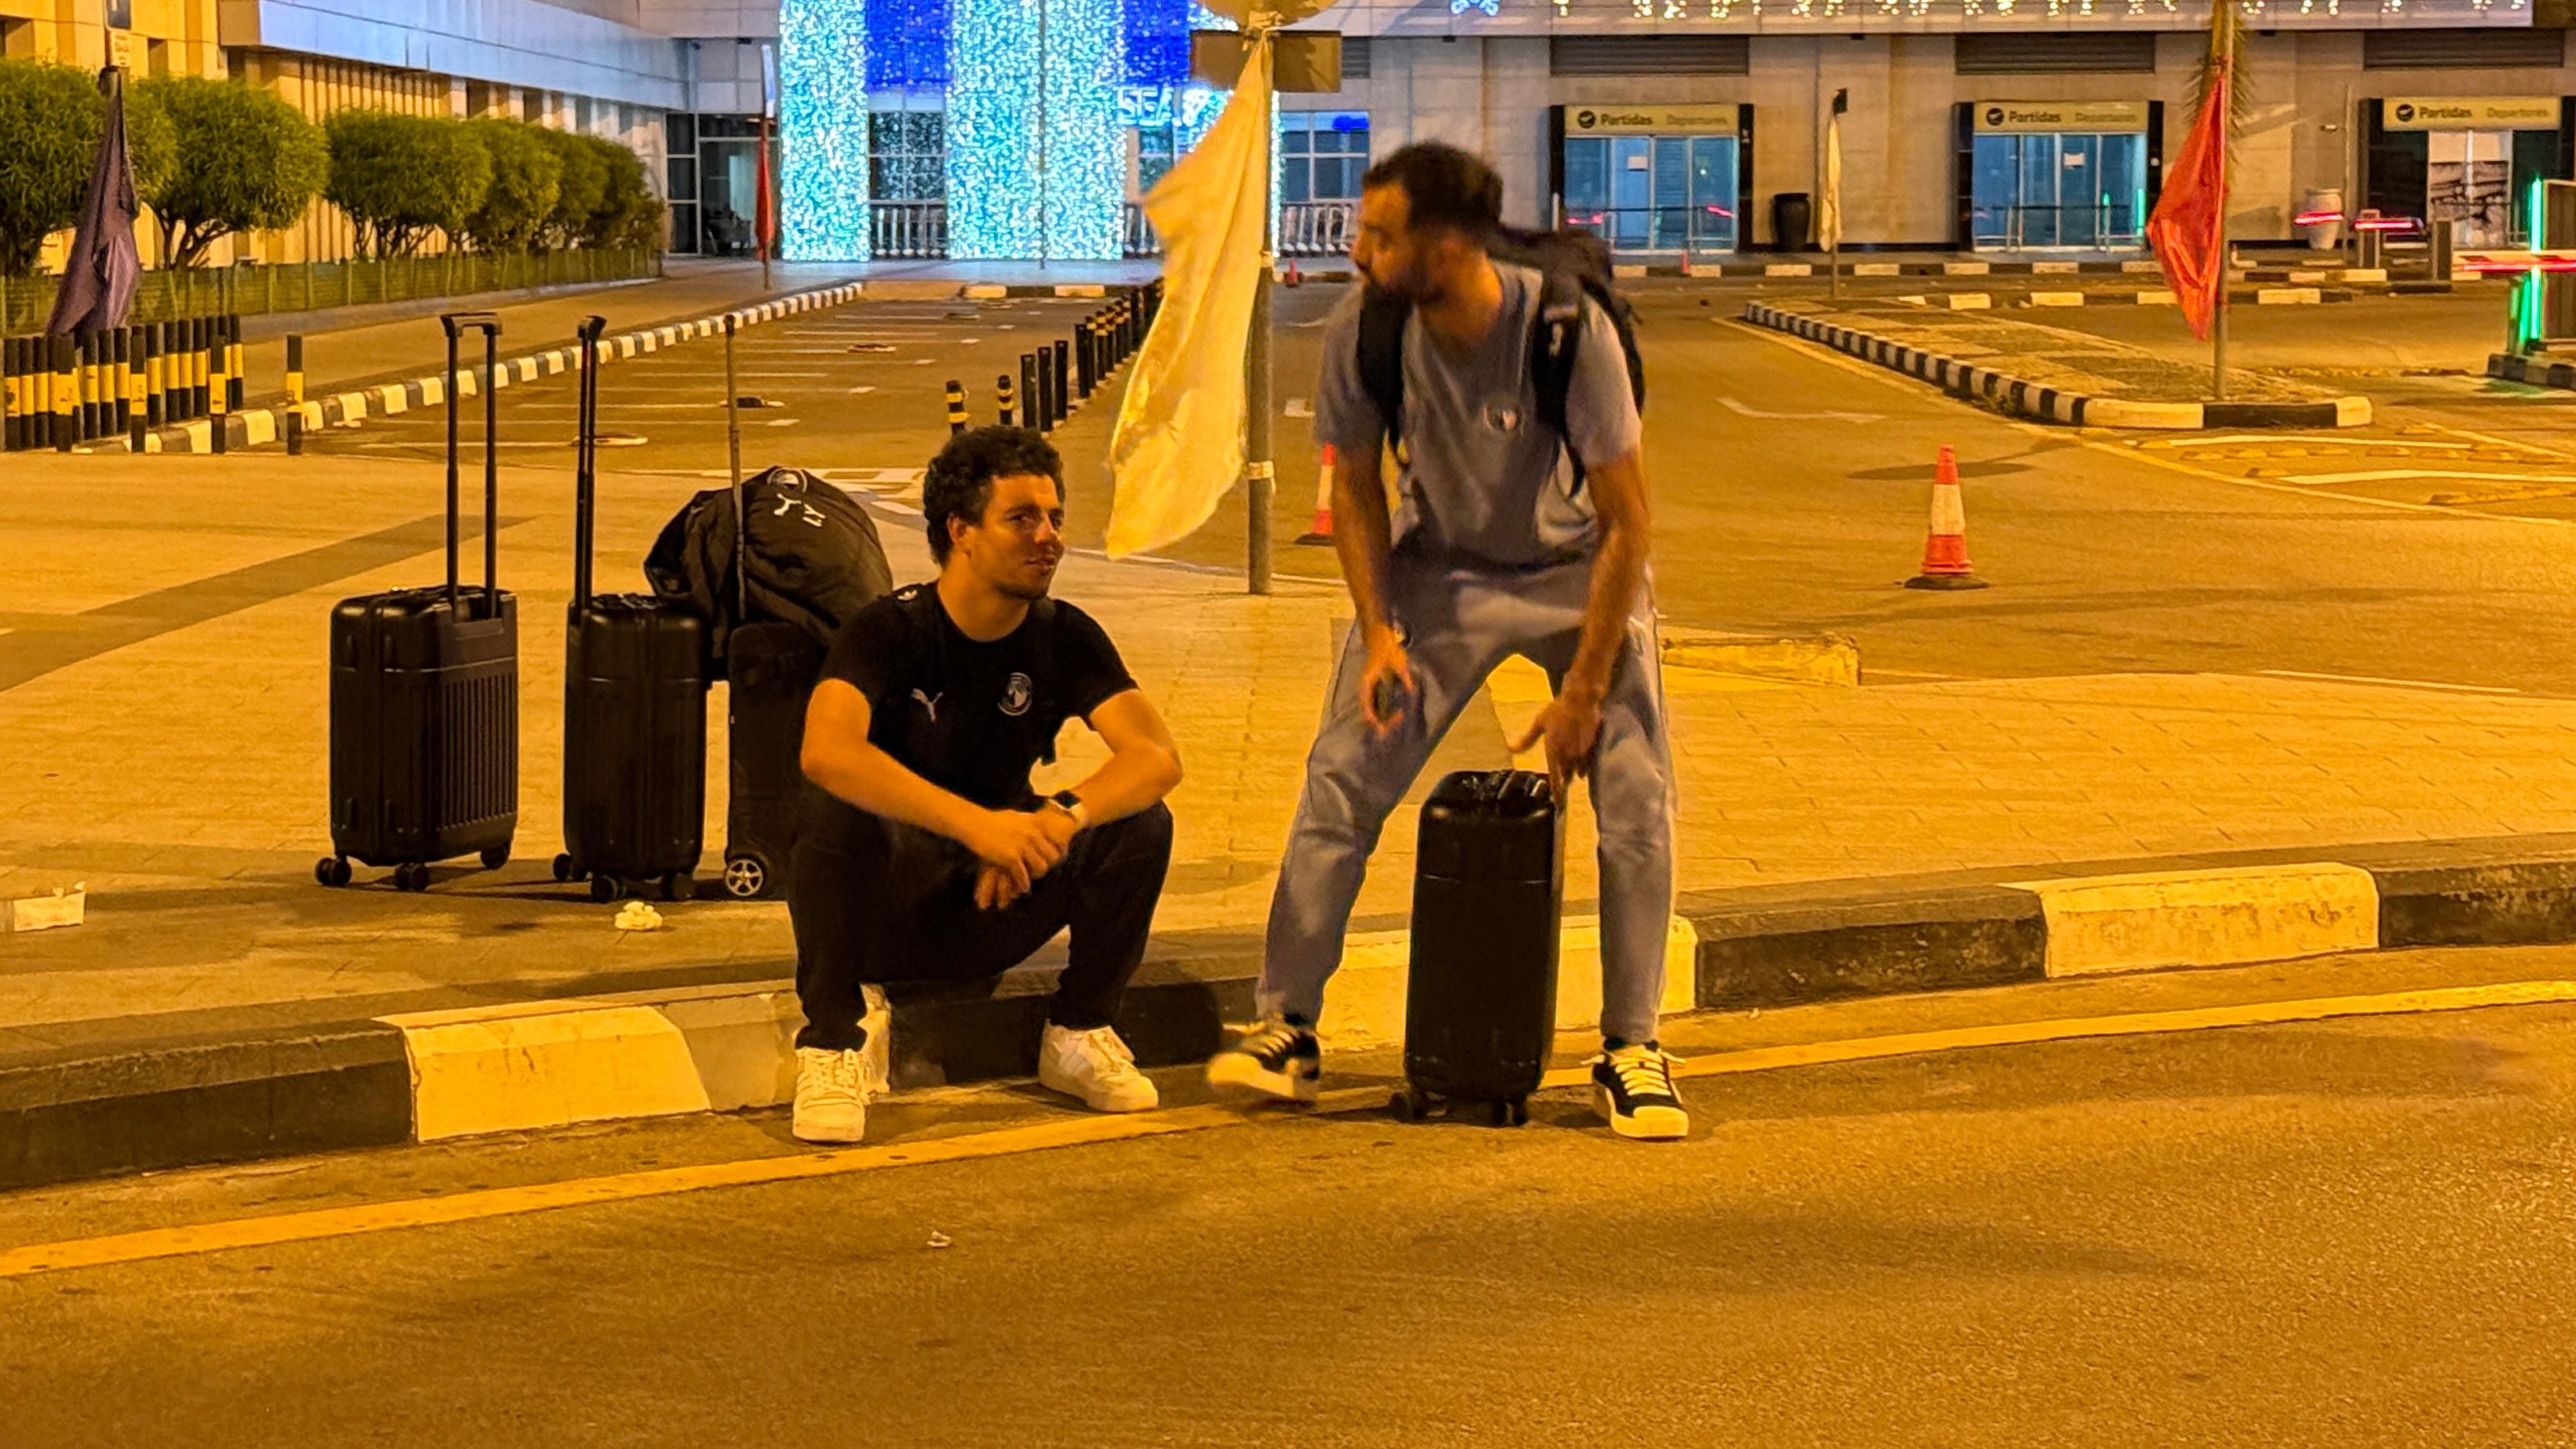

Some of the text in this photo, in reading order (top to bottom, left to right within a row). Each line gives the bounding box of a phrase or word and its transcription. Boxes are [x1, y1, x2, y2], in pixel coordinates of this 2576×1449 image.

[2009, 110, 2061, 123] Partidas
[2419, 106, 2549, 119] Partidas Departures
[1600, 113, 1728, 126] Partidas Departures
